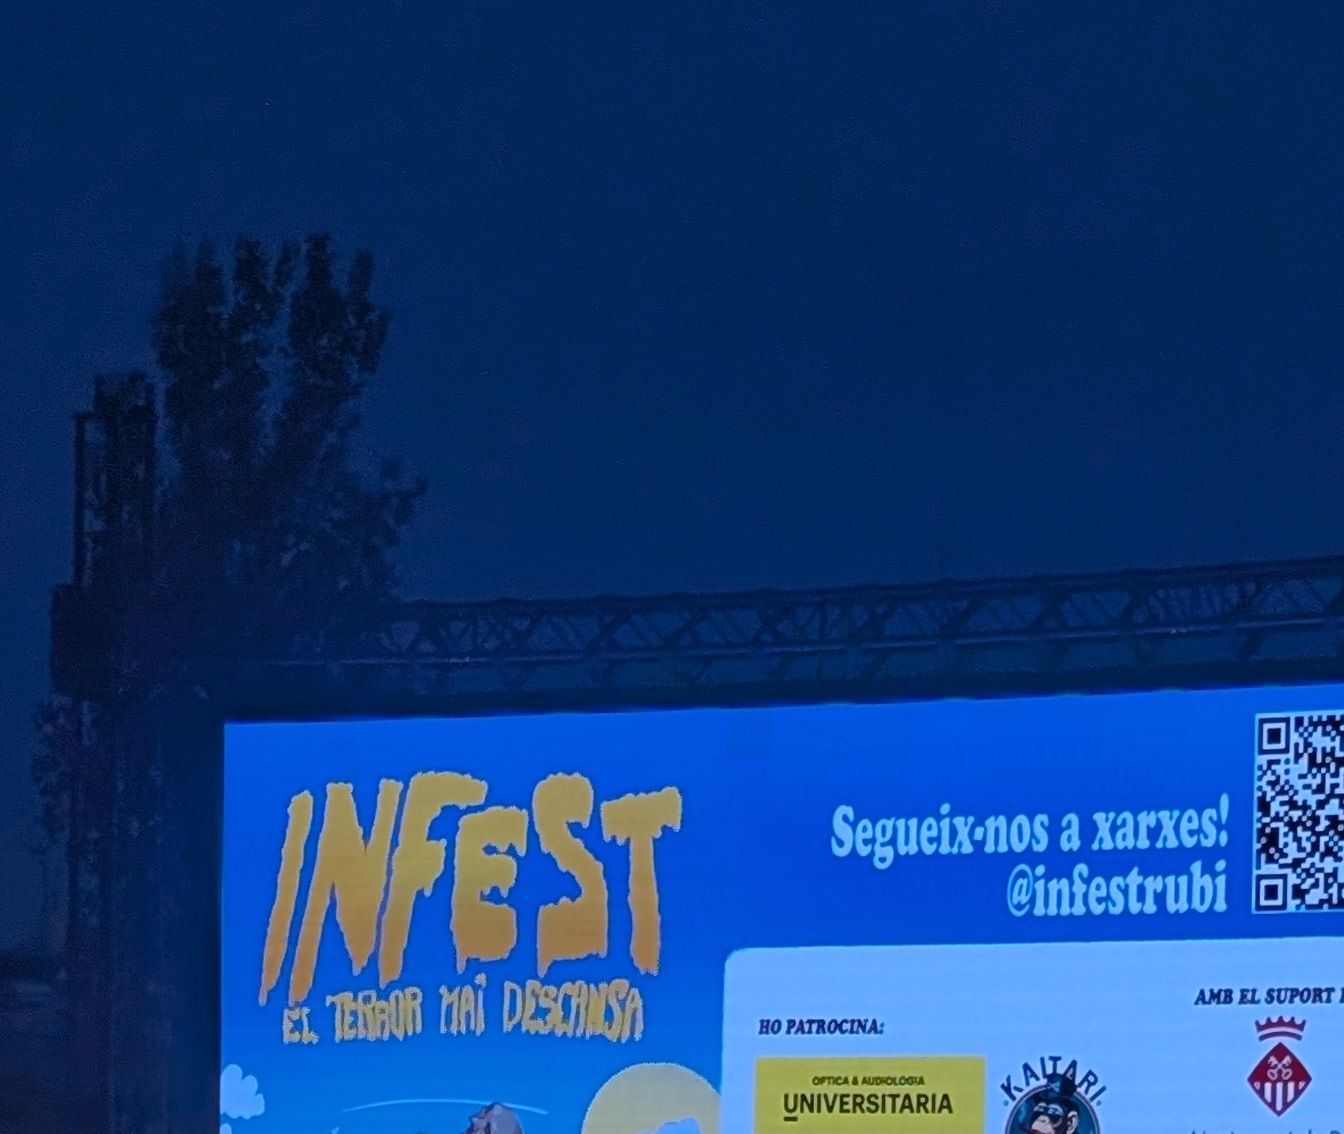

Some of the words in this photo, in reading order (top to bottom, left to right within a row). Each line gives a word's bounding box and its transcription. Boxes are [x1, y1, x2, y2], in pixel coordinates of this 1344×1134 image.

[831, 803, 1049, 870] Segueix-nos
[1060, 812, 1080, 852] a
[1091, 793, 1229, 851] xarxes!
[1006, 858, 1227, 917] @infestrubi
[282, 1007, 319, 1044] EL
[503, 978, 644, 1043] DESCANSA
[1194, 988, 1233, 1005] AMB
[1238, 988, 1261, 1005] EL
[1264, 987, 1335, 1005] SUPORT
[758, 1019, 782, 1035] HO
[785, 1019, 885, 1035] PATROCINA:
[1000, 1055, 1107, 1103] KAITARI
[783, 1093, 953, 1115] UNIVERSITARIA
